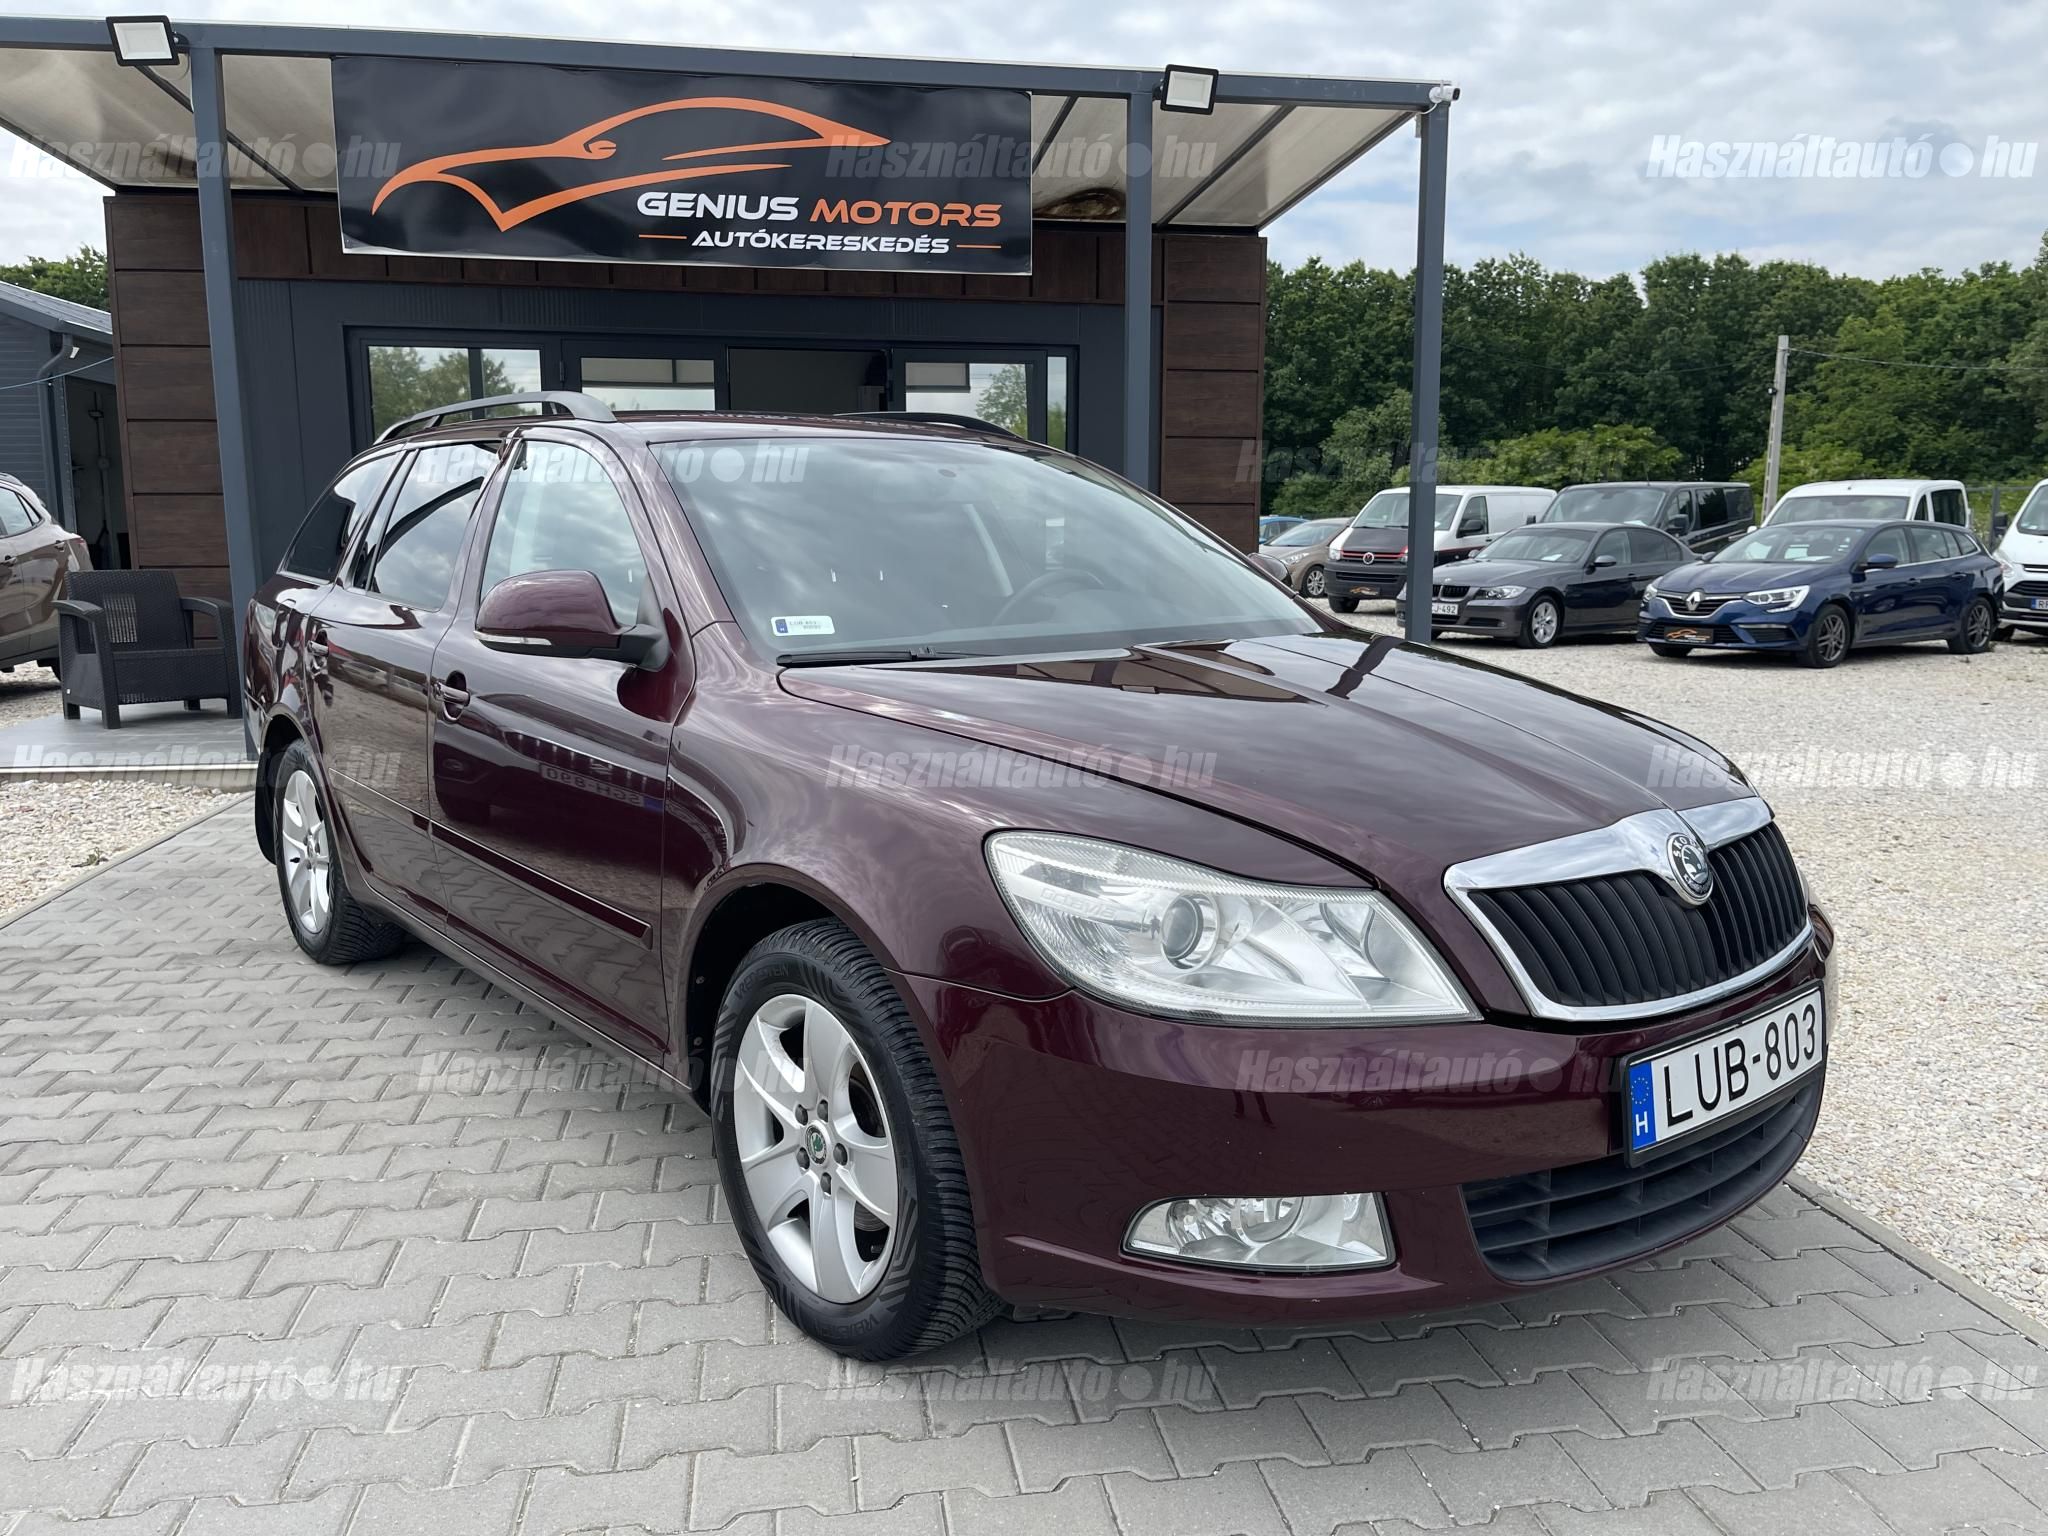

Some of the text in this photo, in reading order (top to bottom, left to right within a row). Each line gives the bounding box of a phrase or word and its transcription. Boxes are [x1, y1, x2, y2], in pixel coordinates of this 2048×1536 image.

[636, 191, 1003, 228] GENIUS MOTORS
[691, 228, 950, 254] AUTÓKERESKEDÉS
[1664, 1003, 1816, 1128] LUB-803
[1635, 1111, 1649, 1137] H
